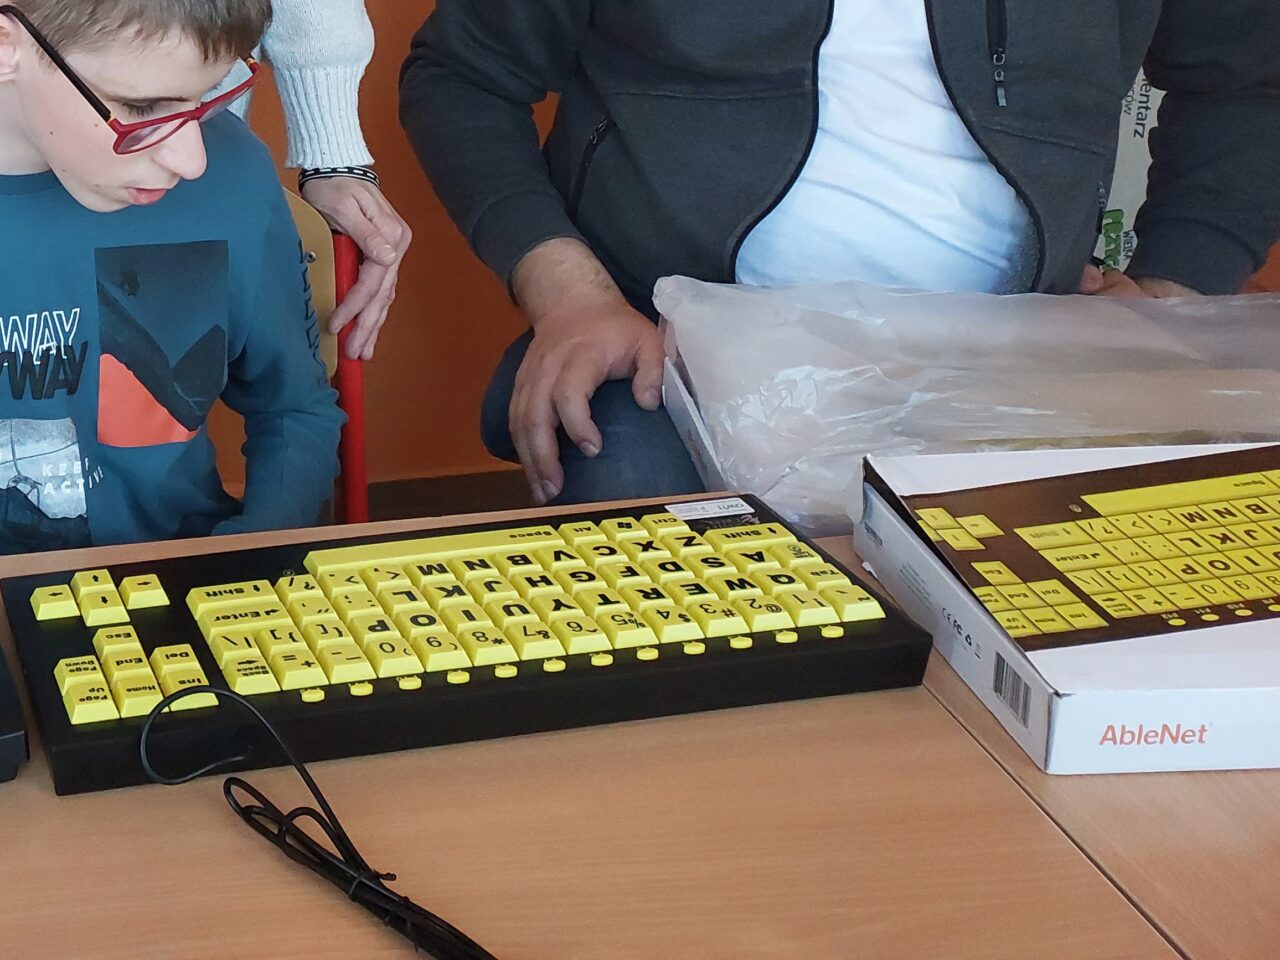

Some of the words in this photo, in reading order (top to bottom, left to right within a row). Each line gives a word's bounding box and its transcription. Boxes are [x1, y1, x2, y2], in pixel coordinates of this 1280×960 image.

[508, 530, 553, 539] Space
[722, 529, 762, 540] Shift
[810, 569, 838, 577] Tab
[204, 588, 245, 597] Shift
[213, 611, 261, 622] Enter
[105, 632, 132, 640] Esc
[165, 652, 190, 660] Del
[115, 657, 143, 666] End
[178, 678, 202, 686] Ins
[126, 685, 156, 694] Home
[79, 694, 108, 703] Page
[1099, 723, 1208, 746] AbleNet
